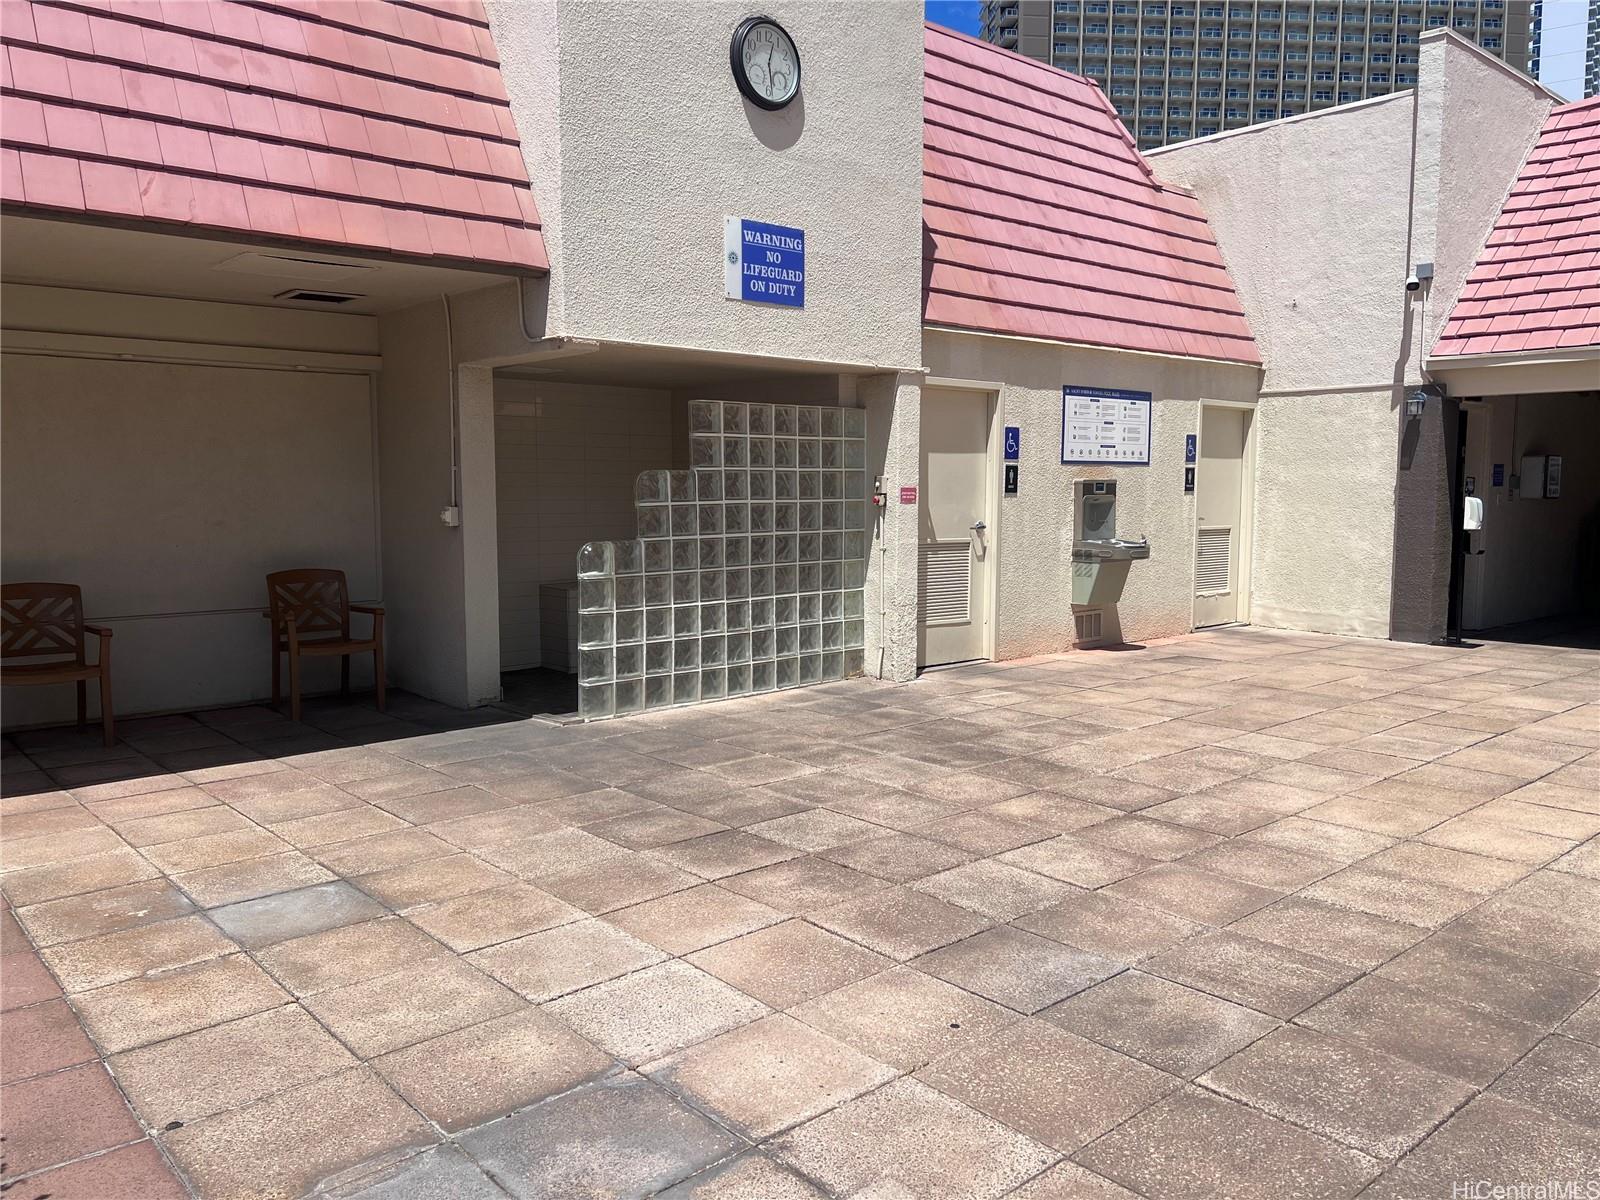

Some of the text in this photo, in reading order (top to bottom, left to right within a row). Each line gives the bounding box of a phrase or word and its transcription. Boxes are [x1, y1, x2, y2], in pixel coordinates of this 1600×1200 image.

[756, 31, 762, 43] 11
[765, 30, 773, 43] 12
[747, 39, 756, 51] 10
[745, 53, 752, 64] 9
[782, 49, 788, 62] 2
[784, 64, 791, 76] 3
[765, 85, 772, 97] 6
[744, 230, 803, 251] WARNING
[766, 251, 782, 264] NO
[743, 263, 803, 283] LIFEGUARD
[750, 279, 797, 297] ON DUTY
